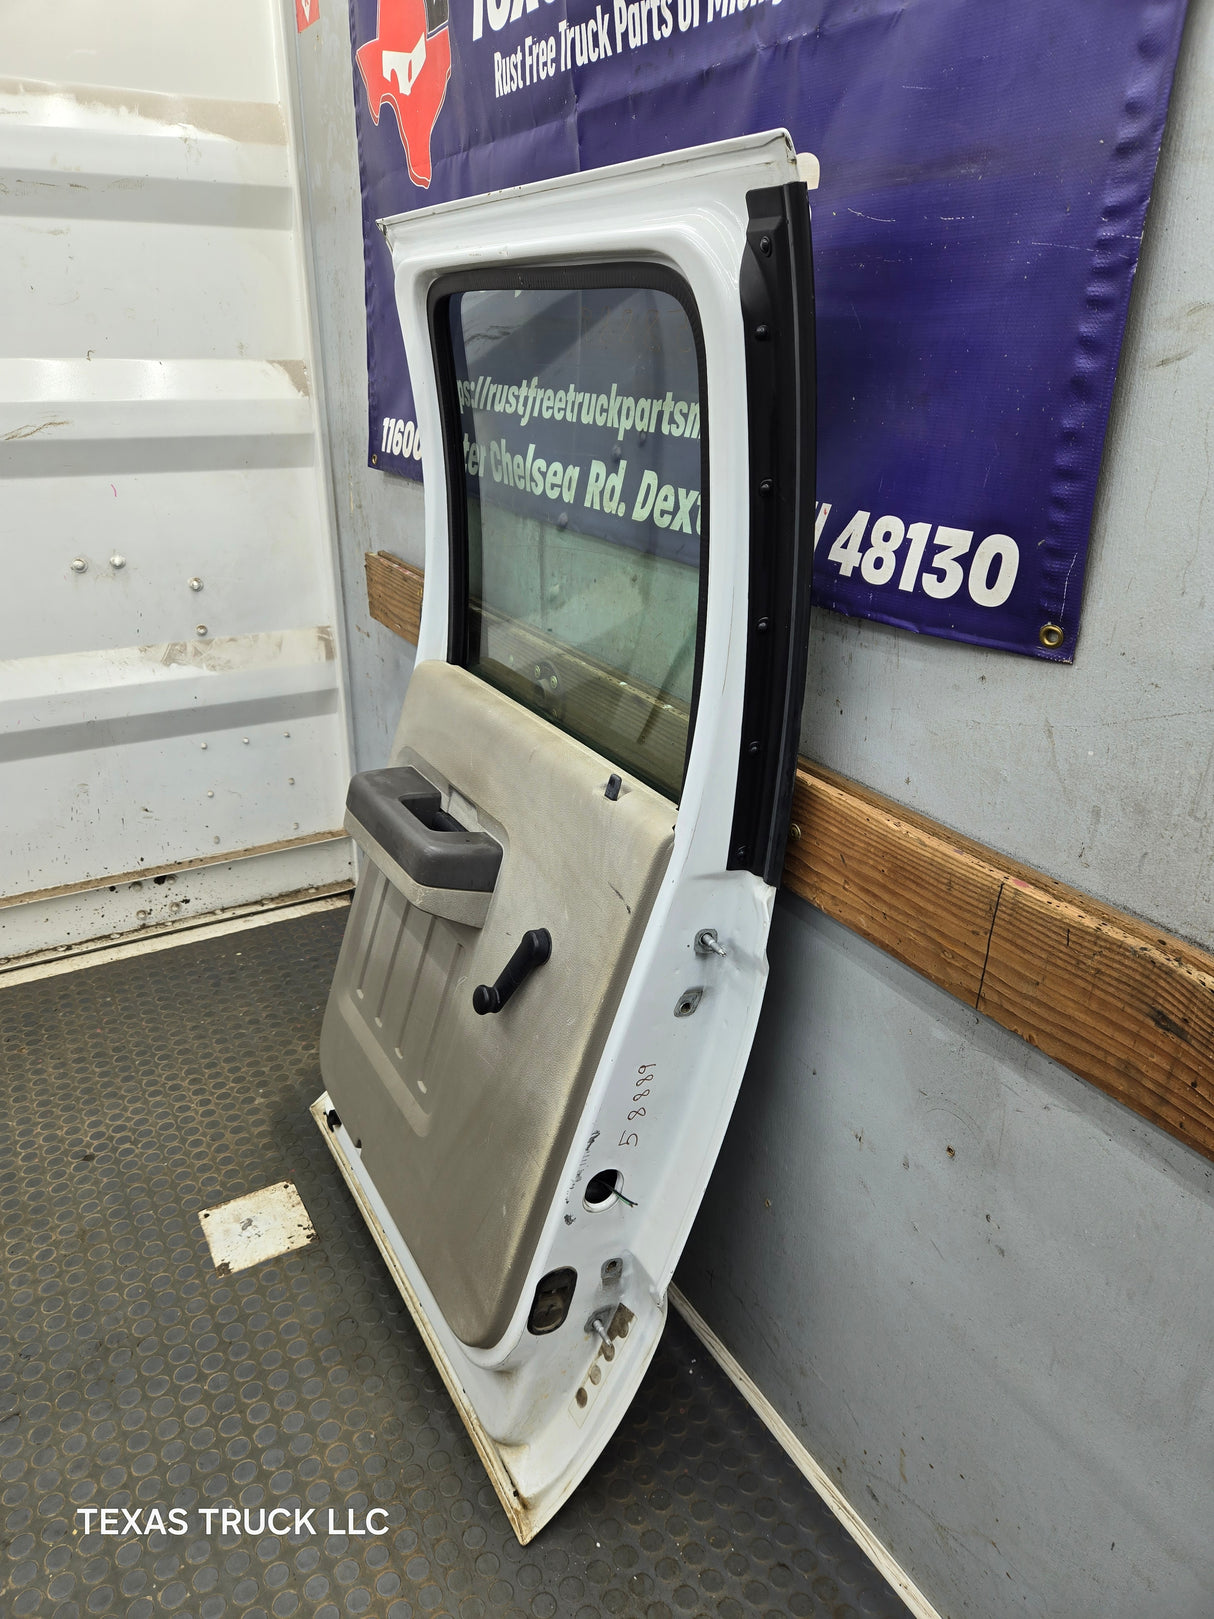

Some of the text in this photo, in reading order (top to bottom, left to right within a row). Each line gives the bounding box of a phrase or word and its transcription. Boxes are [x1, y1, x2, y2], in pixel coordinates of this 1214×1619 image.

[493, 45, 524, 99] Rust
[524, 35, 556, 86] Free
[558, 5, 613, 73] Truck
[613, 0, 673, 53] Parts
[489, 438, 580, 504] Chelsea
[584, 459, 627, 517] Rd.
[827, 510, 1020, 607] 48130
[618, 1063, 656, 1147] 58889
